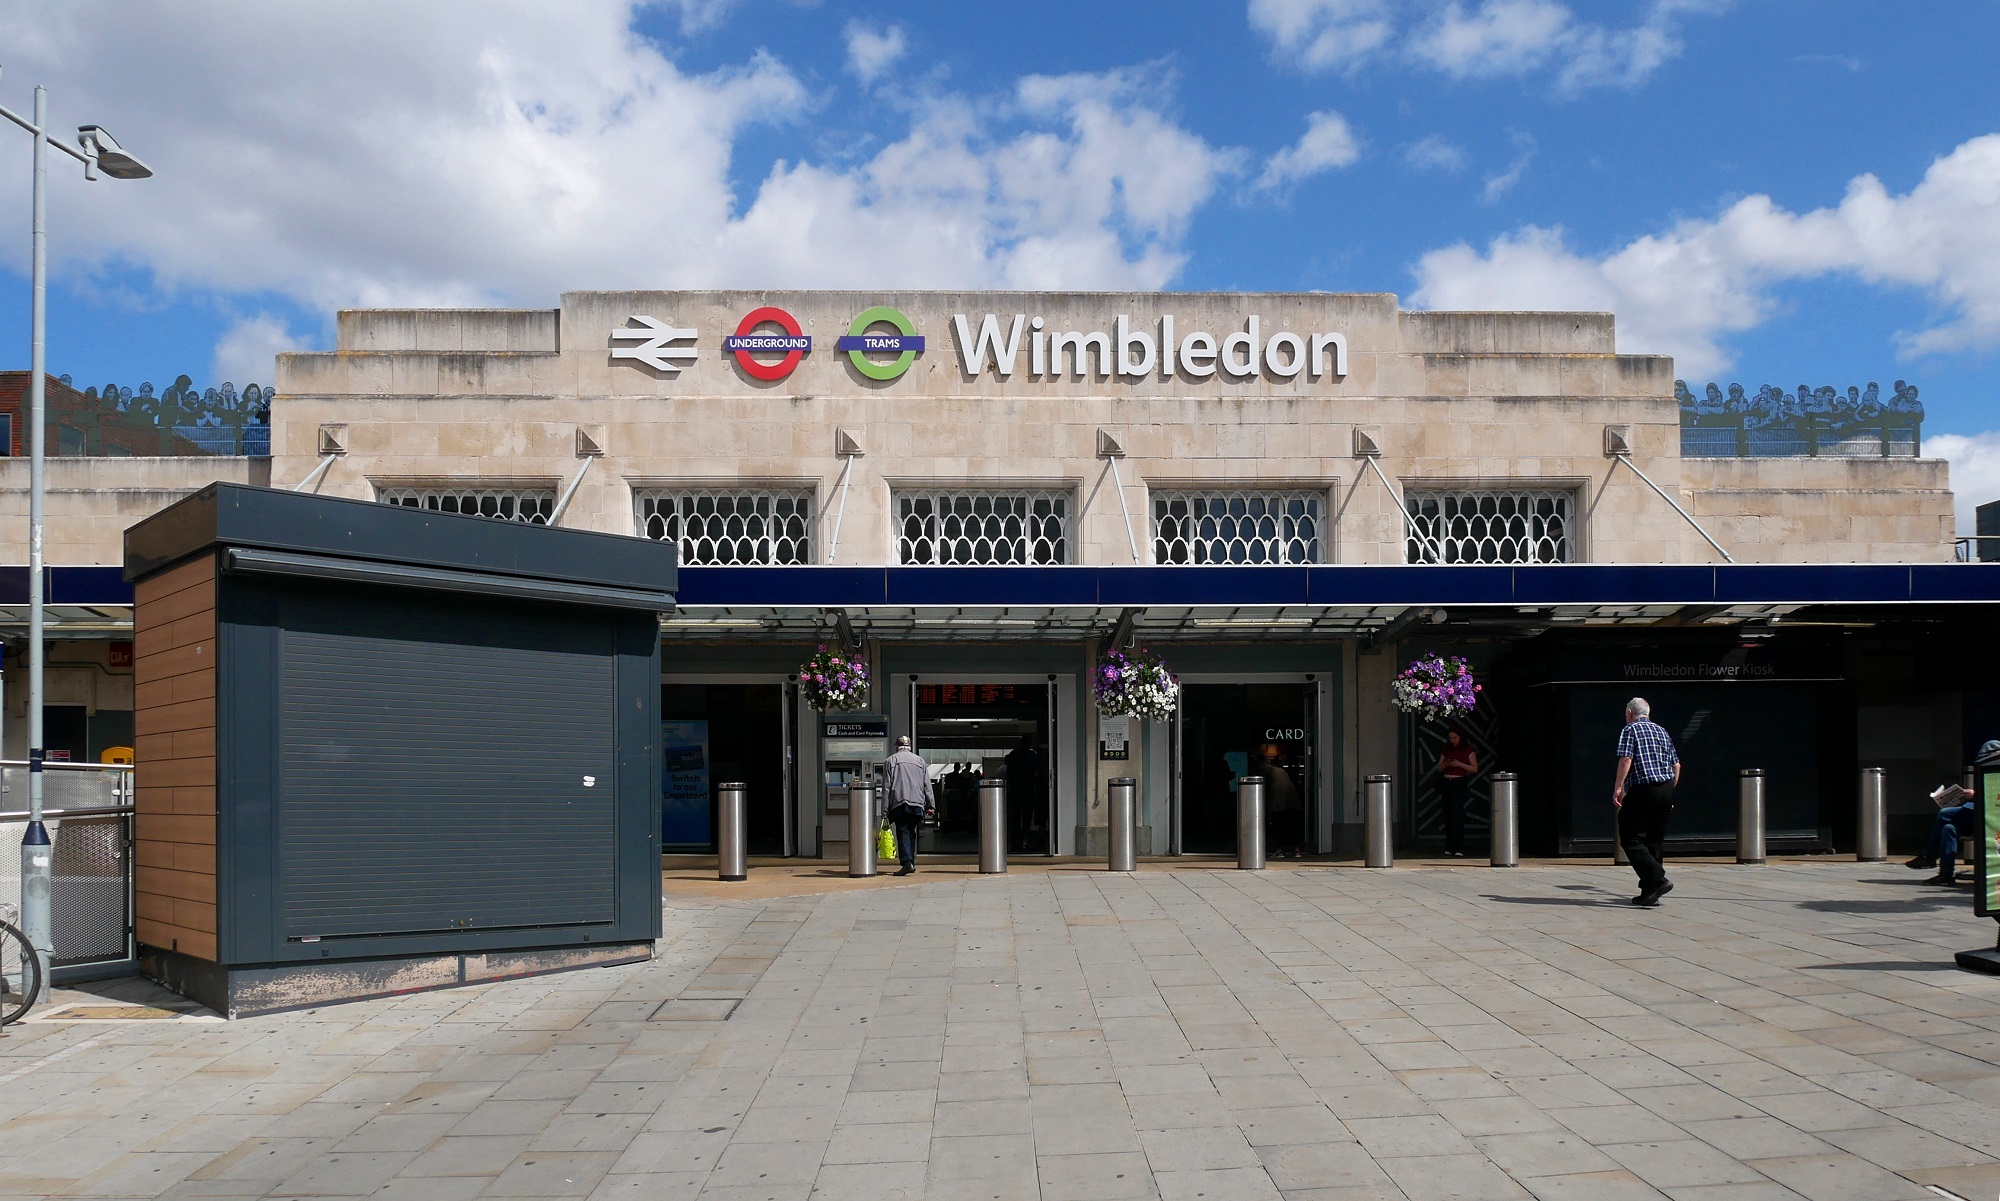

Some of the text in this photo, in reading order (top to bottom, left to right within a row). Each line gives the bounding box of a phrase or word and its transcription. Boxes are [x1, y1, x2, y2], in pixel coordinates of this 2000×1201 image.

[729, 338, 808, 349] UNDERGROUND
[864, 338, 900, 349] TRAMS
[953, 314, 1348, 376] Wimbledon
[1623, 662, 1775, 676] Wimbledon Flower Kiosk
[1265, 728, 1304, 740] CARD
[671, 774, 700, 782] Switch
[664, 791, 707, 799] Smartcard
